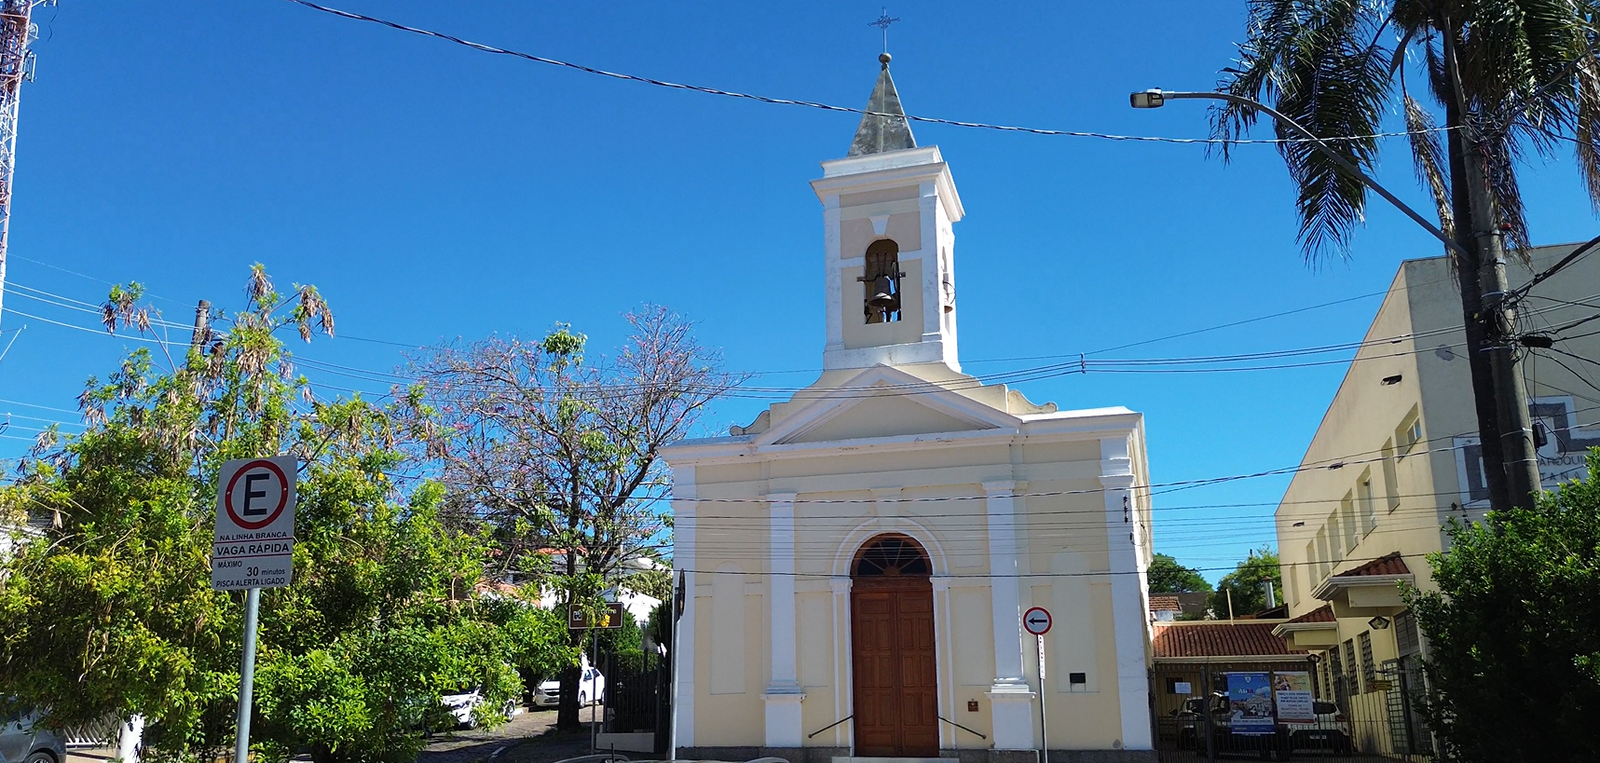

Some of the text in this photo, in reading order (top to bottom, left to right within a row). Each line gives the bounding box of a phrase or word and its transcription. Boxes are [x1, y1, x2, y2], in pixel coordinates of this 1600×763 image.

[243, 473, 270, 516] E
[255, 531, 287, 539] BRANCA
[216, 543, 290, 556] VAGA RÁPIDA
[217, 560, 243, 568] MÁXIMO
[246, 566, 286, 577] 30 minutos
[216, 577, 285, 588] PISCA ALERTA LIGADO
